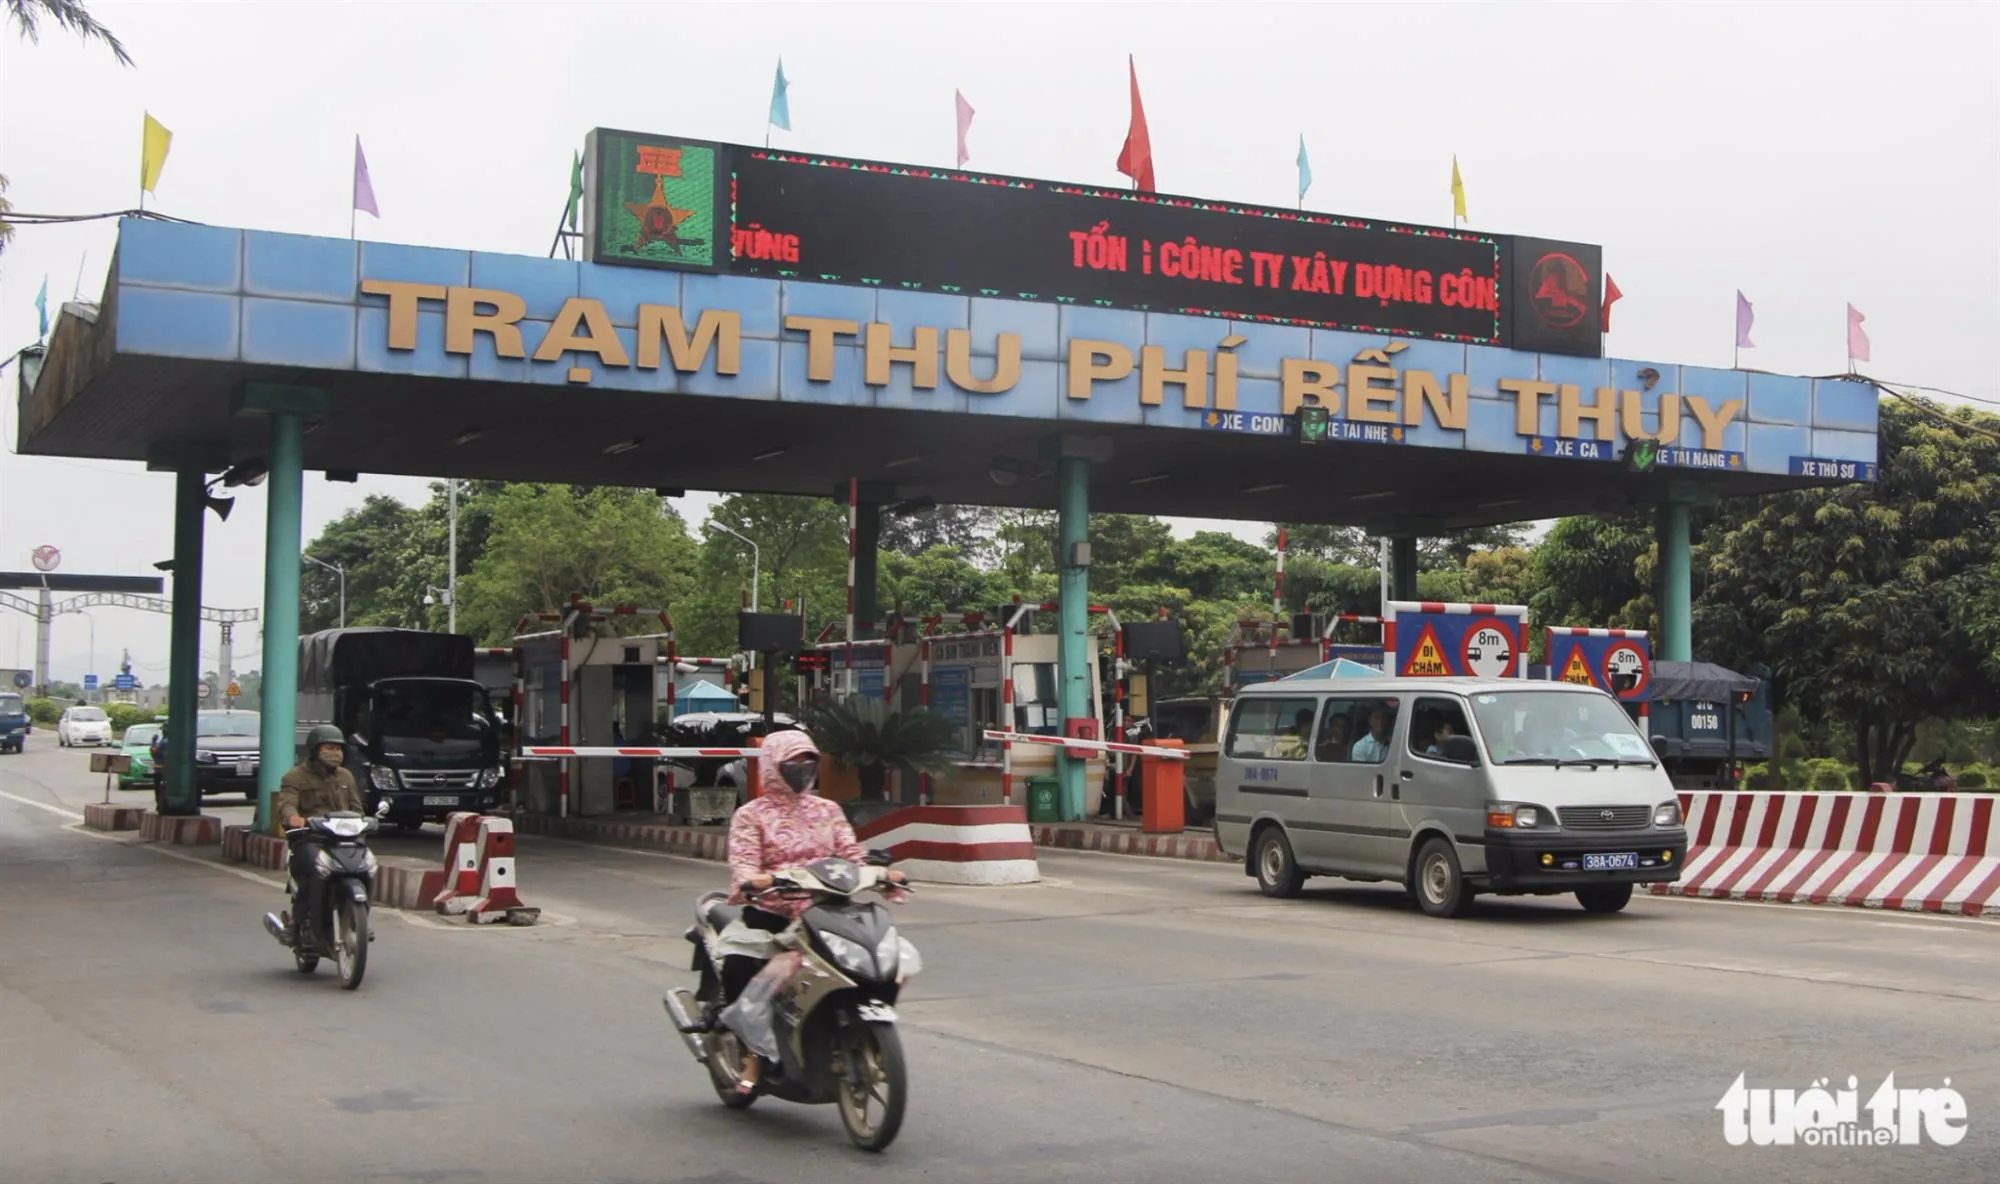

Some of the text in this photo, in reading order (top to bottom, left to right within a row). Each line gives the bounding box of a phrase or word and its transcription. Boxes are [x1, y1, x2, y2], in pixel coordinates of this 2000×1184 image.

[1250, 252, 1284, 288] TY
[1291, 251, 1348, 295] XÂY
[1355, 264, 1433, 307] DỰNG
[360, 279, 1743, 450] TRẠM THU PHÍ BẾN THỦY
[1222, 413, 1285, 433] XE CON
[1365, 424, 1388, 444] NHẸ
[1555, 440, 1598, 458] XE CA
[1802, 461, 1815, 476] XE
[1478, 631, 1499, 646] 8m
[1618, 651, 1635, 663] 8m
[1691, 714, 1718, 730] 00150
[1586, 854, 1634, 869] 38A-0674
